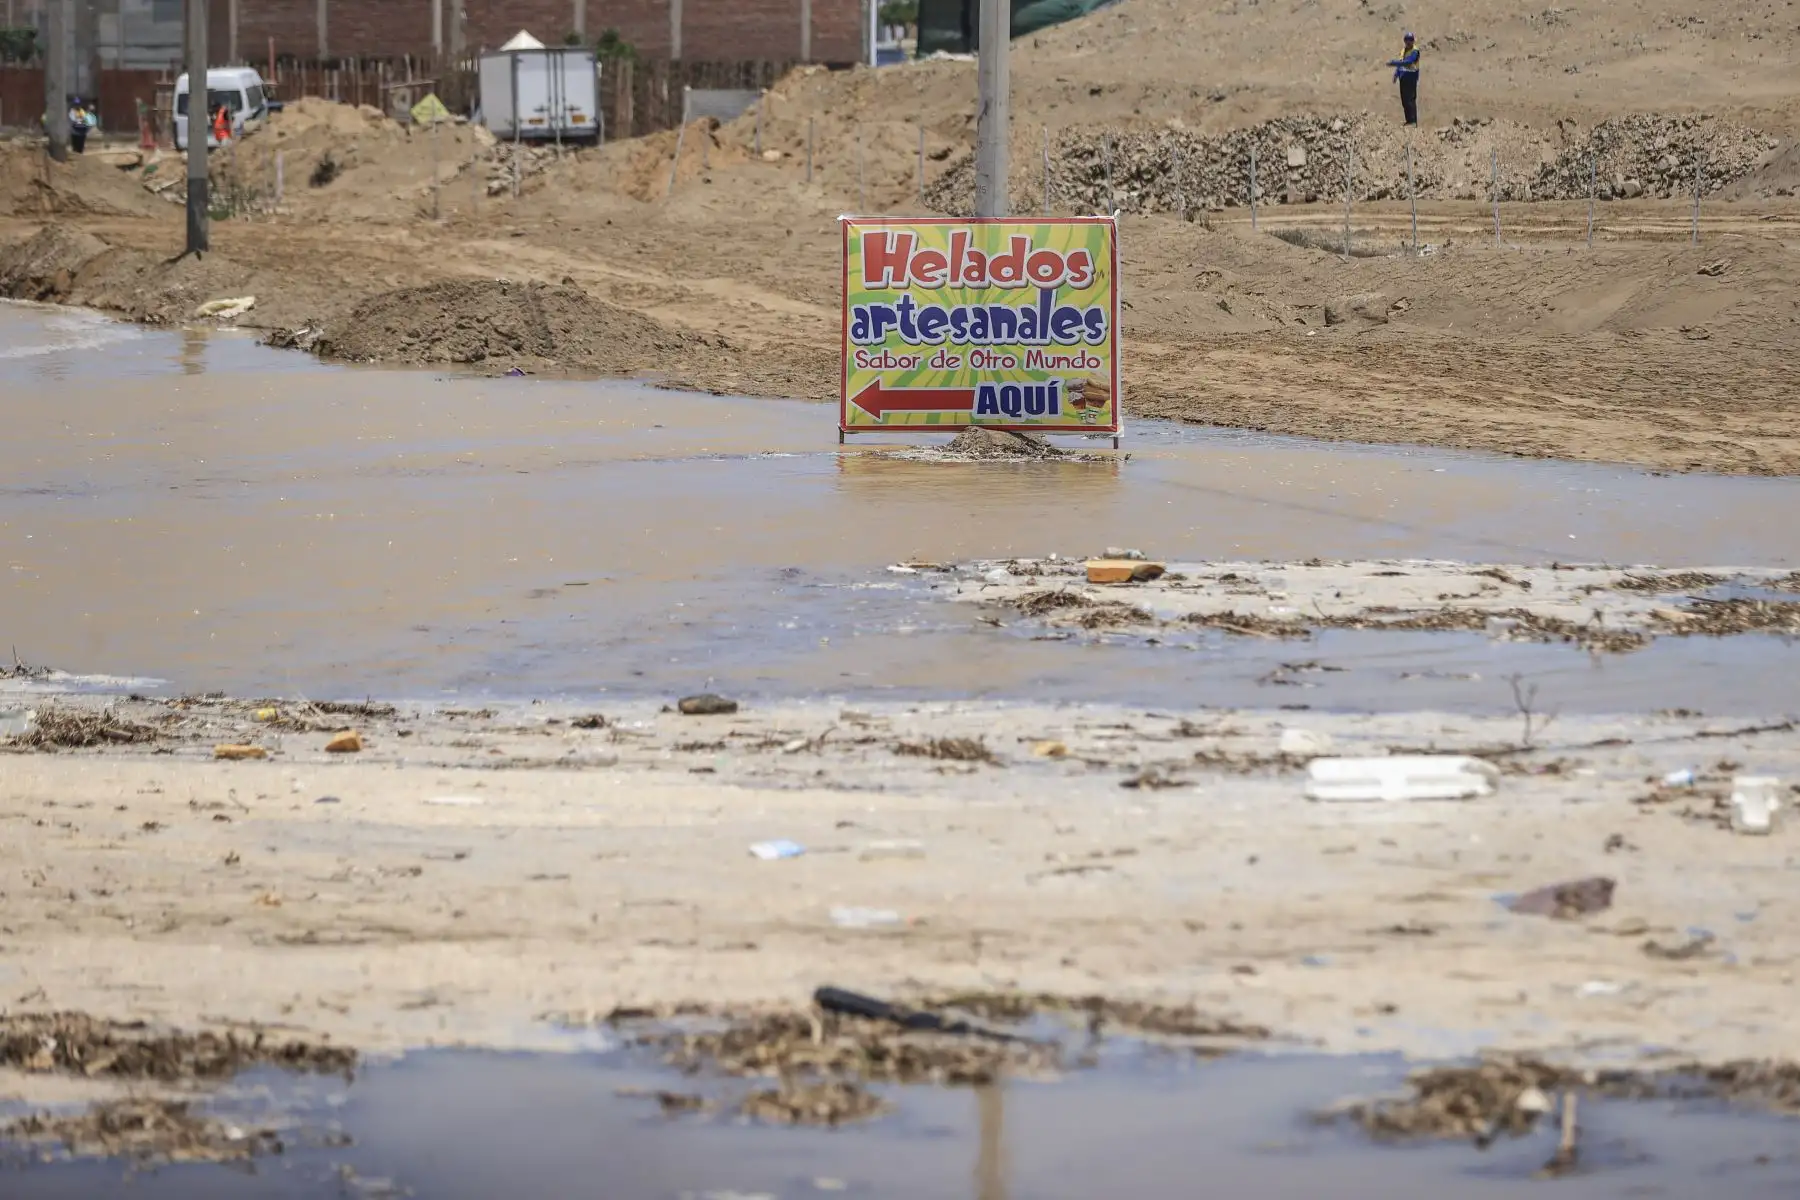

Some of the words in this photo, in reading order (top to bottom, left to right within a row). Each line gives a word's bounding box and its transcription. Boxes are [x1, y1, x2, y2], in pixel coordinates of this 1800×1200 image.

[863, 231, 1092, 283] Helados
[851, 288, 1104, 340] artesanales
[856, 350, 920, 369] Sabor
[930, 350, 960, 369] de
[970, 350, 1015, 369] Otro
[1025, 350, 1100, 369] Mundo
[976, 380, 1059, 417] AQUÍ
